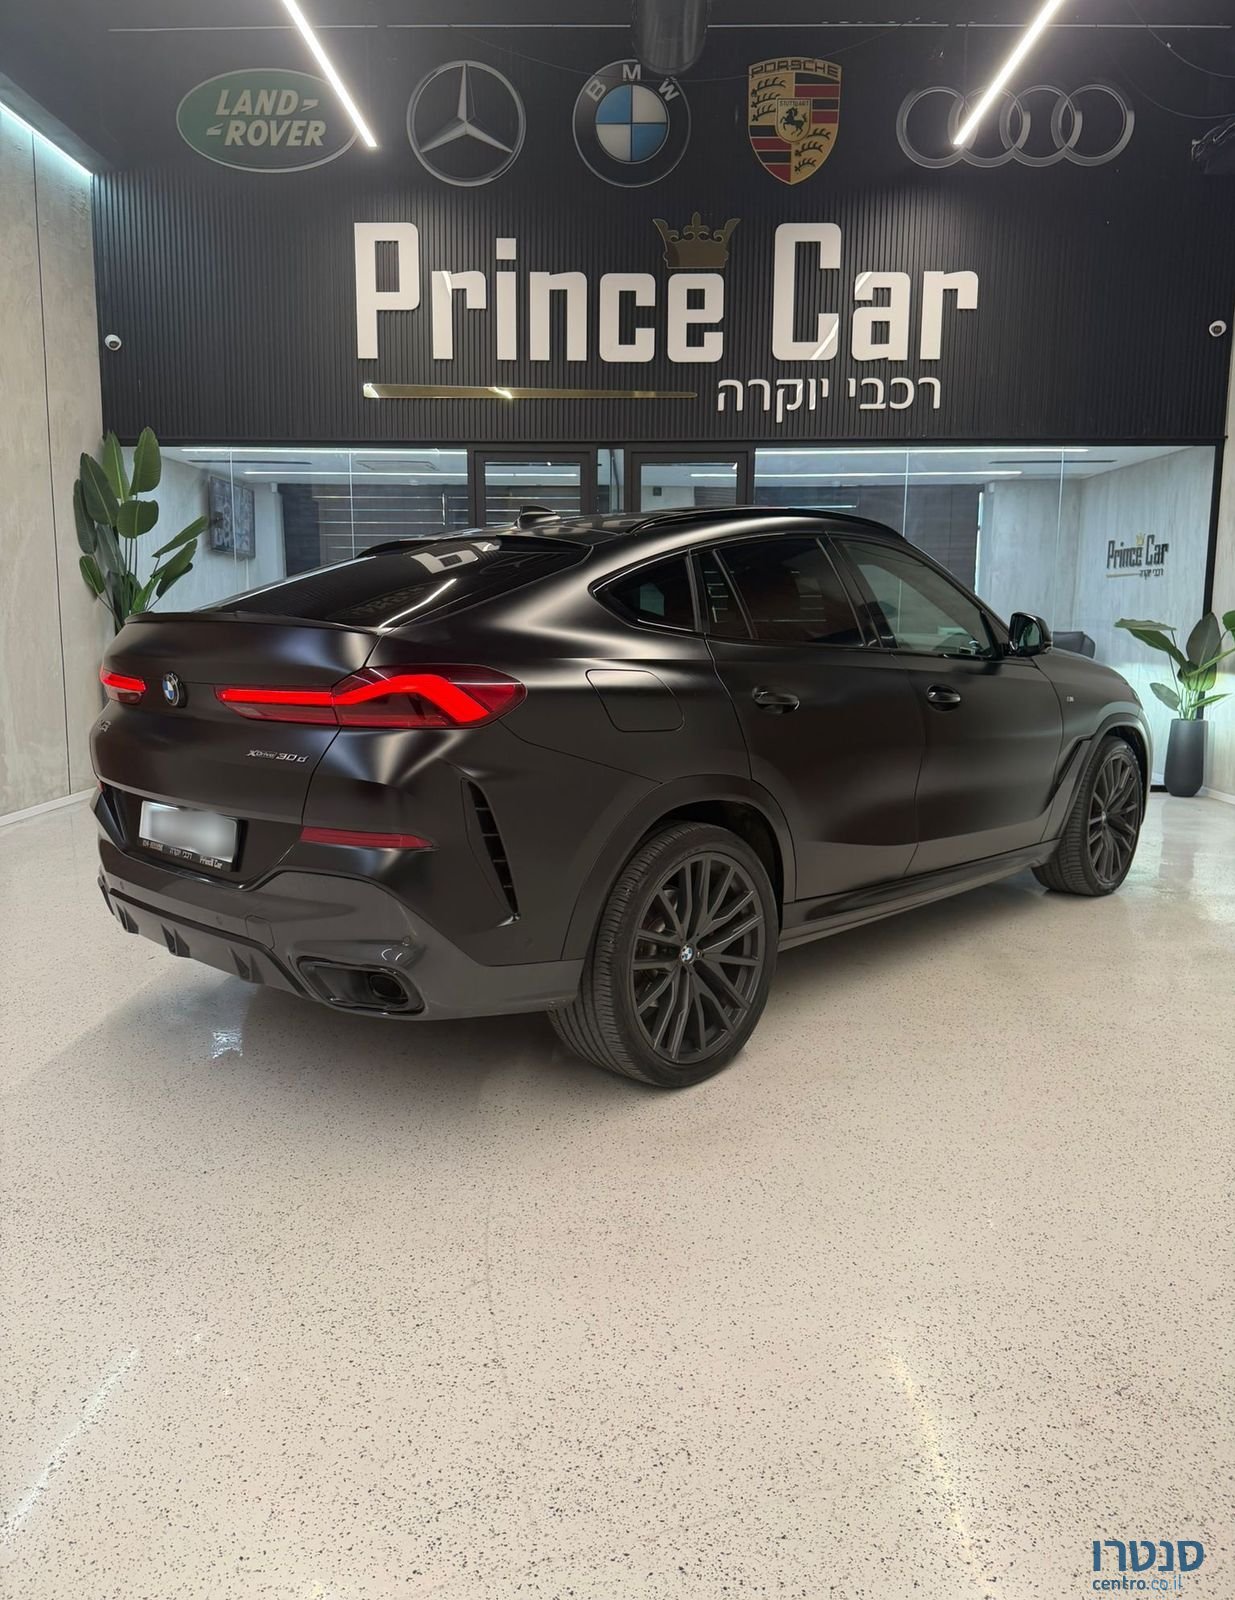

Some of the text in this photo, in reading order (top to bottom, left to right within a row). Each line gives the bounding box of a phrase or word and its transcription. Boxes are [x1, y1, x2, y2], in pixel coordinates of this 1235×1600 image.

[585, 64, 680, 102] BMW
[751, 60, 839, 78] PORSCHE
[215, 89, 300, 116] LAND
[224, 119, 326, 147] ROVER
[354, 222, 979, 363] Prince Car
[717, 377, 941, 423] רכבי יוקרה
[1106, 534, 1169, 569] Prince Car
